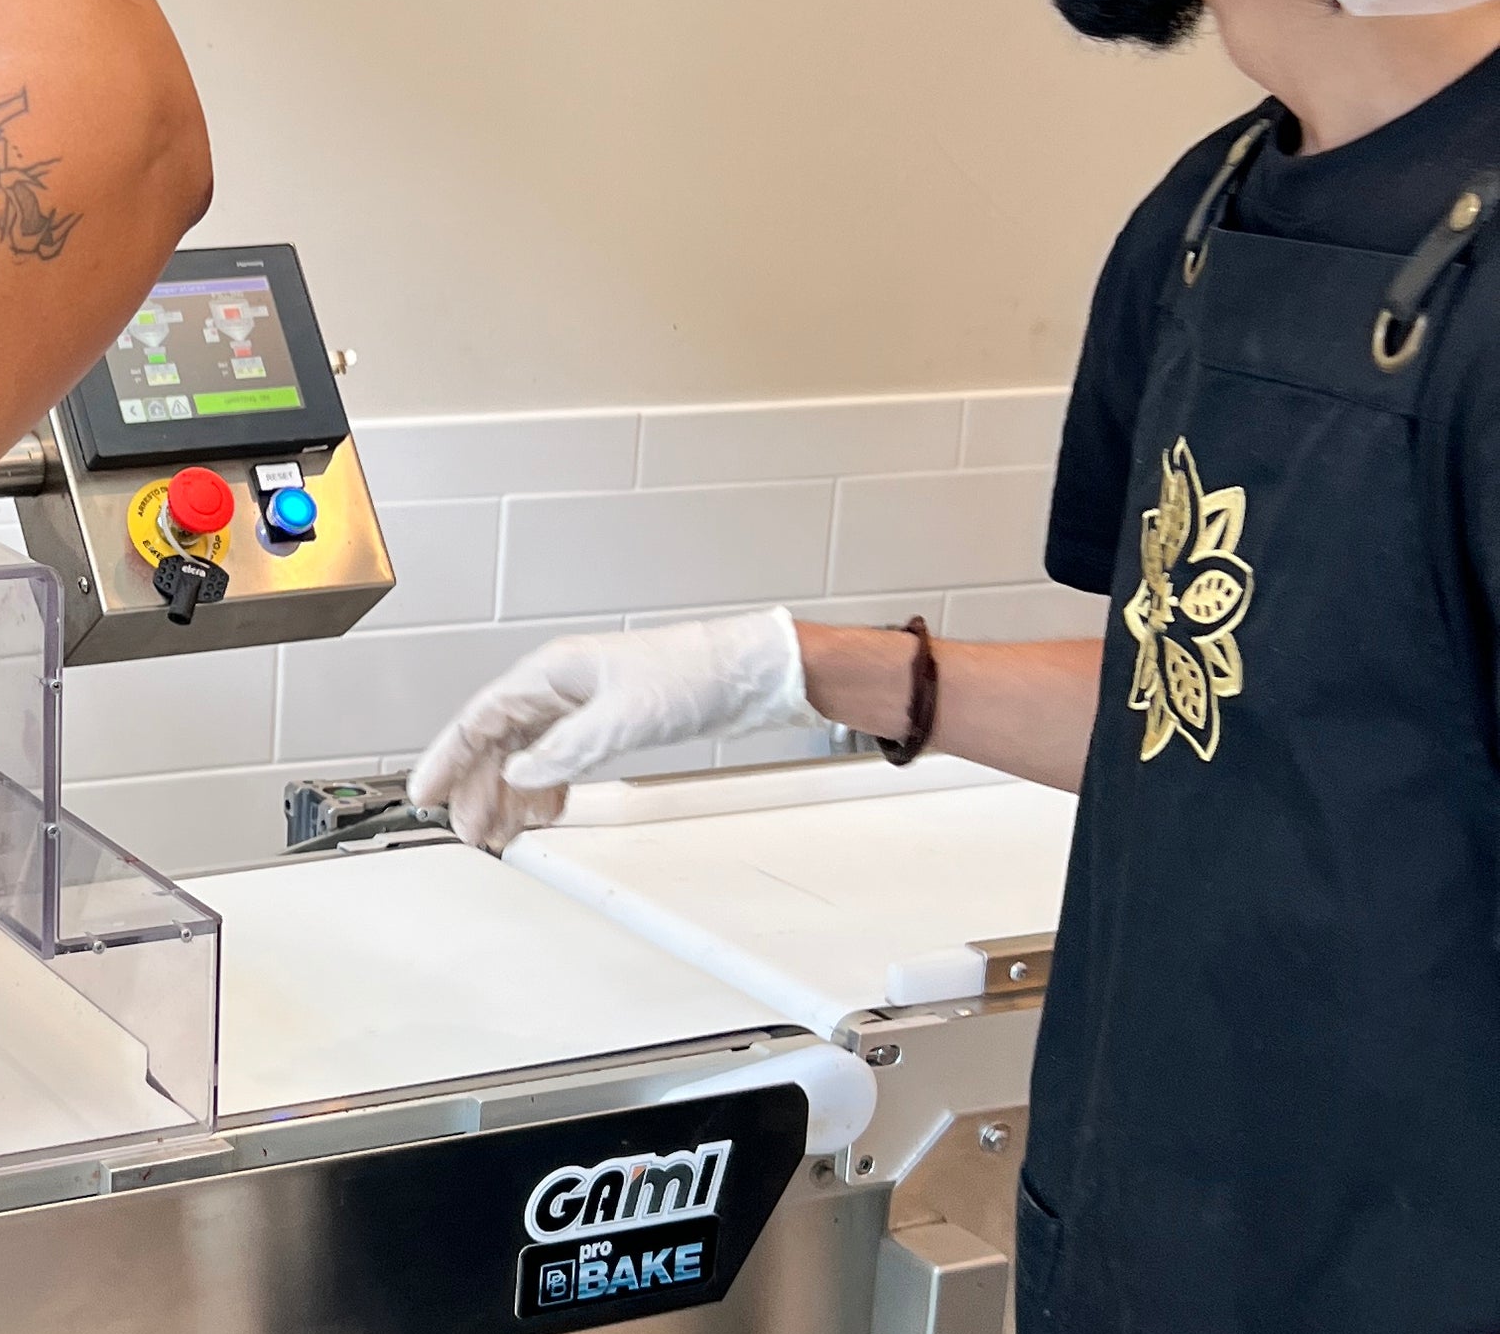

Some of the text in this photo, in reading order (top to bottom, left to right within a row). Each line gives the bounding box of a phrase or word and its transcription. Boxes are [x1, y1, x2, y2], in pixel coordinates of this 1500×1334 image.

[265, 470, 293, 482] RESET
[579, 1240, 612, 1263] pro
[577, 1242, 703, 1300] BAKE
